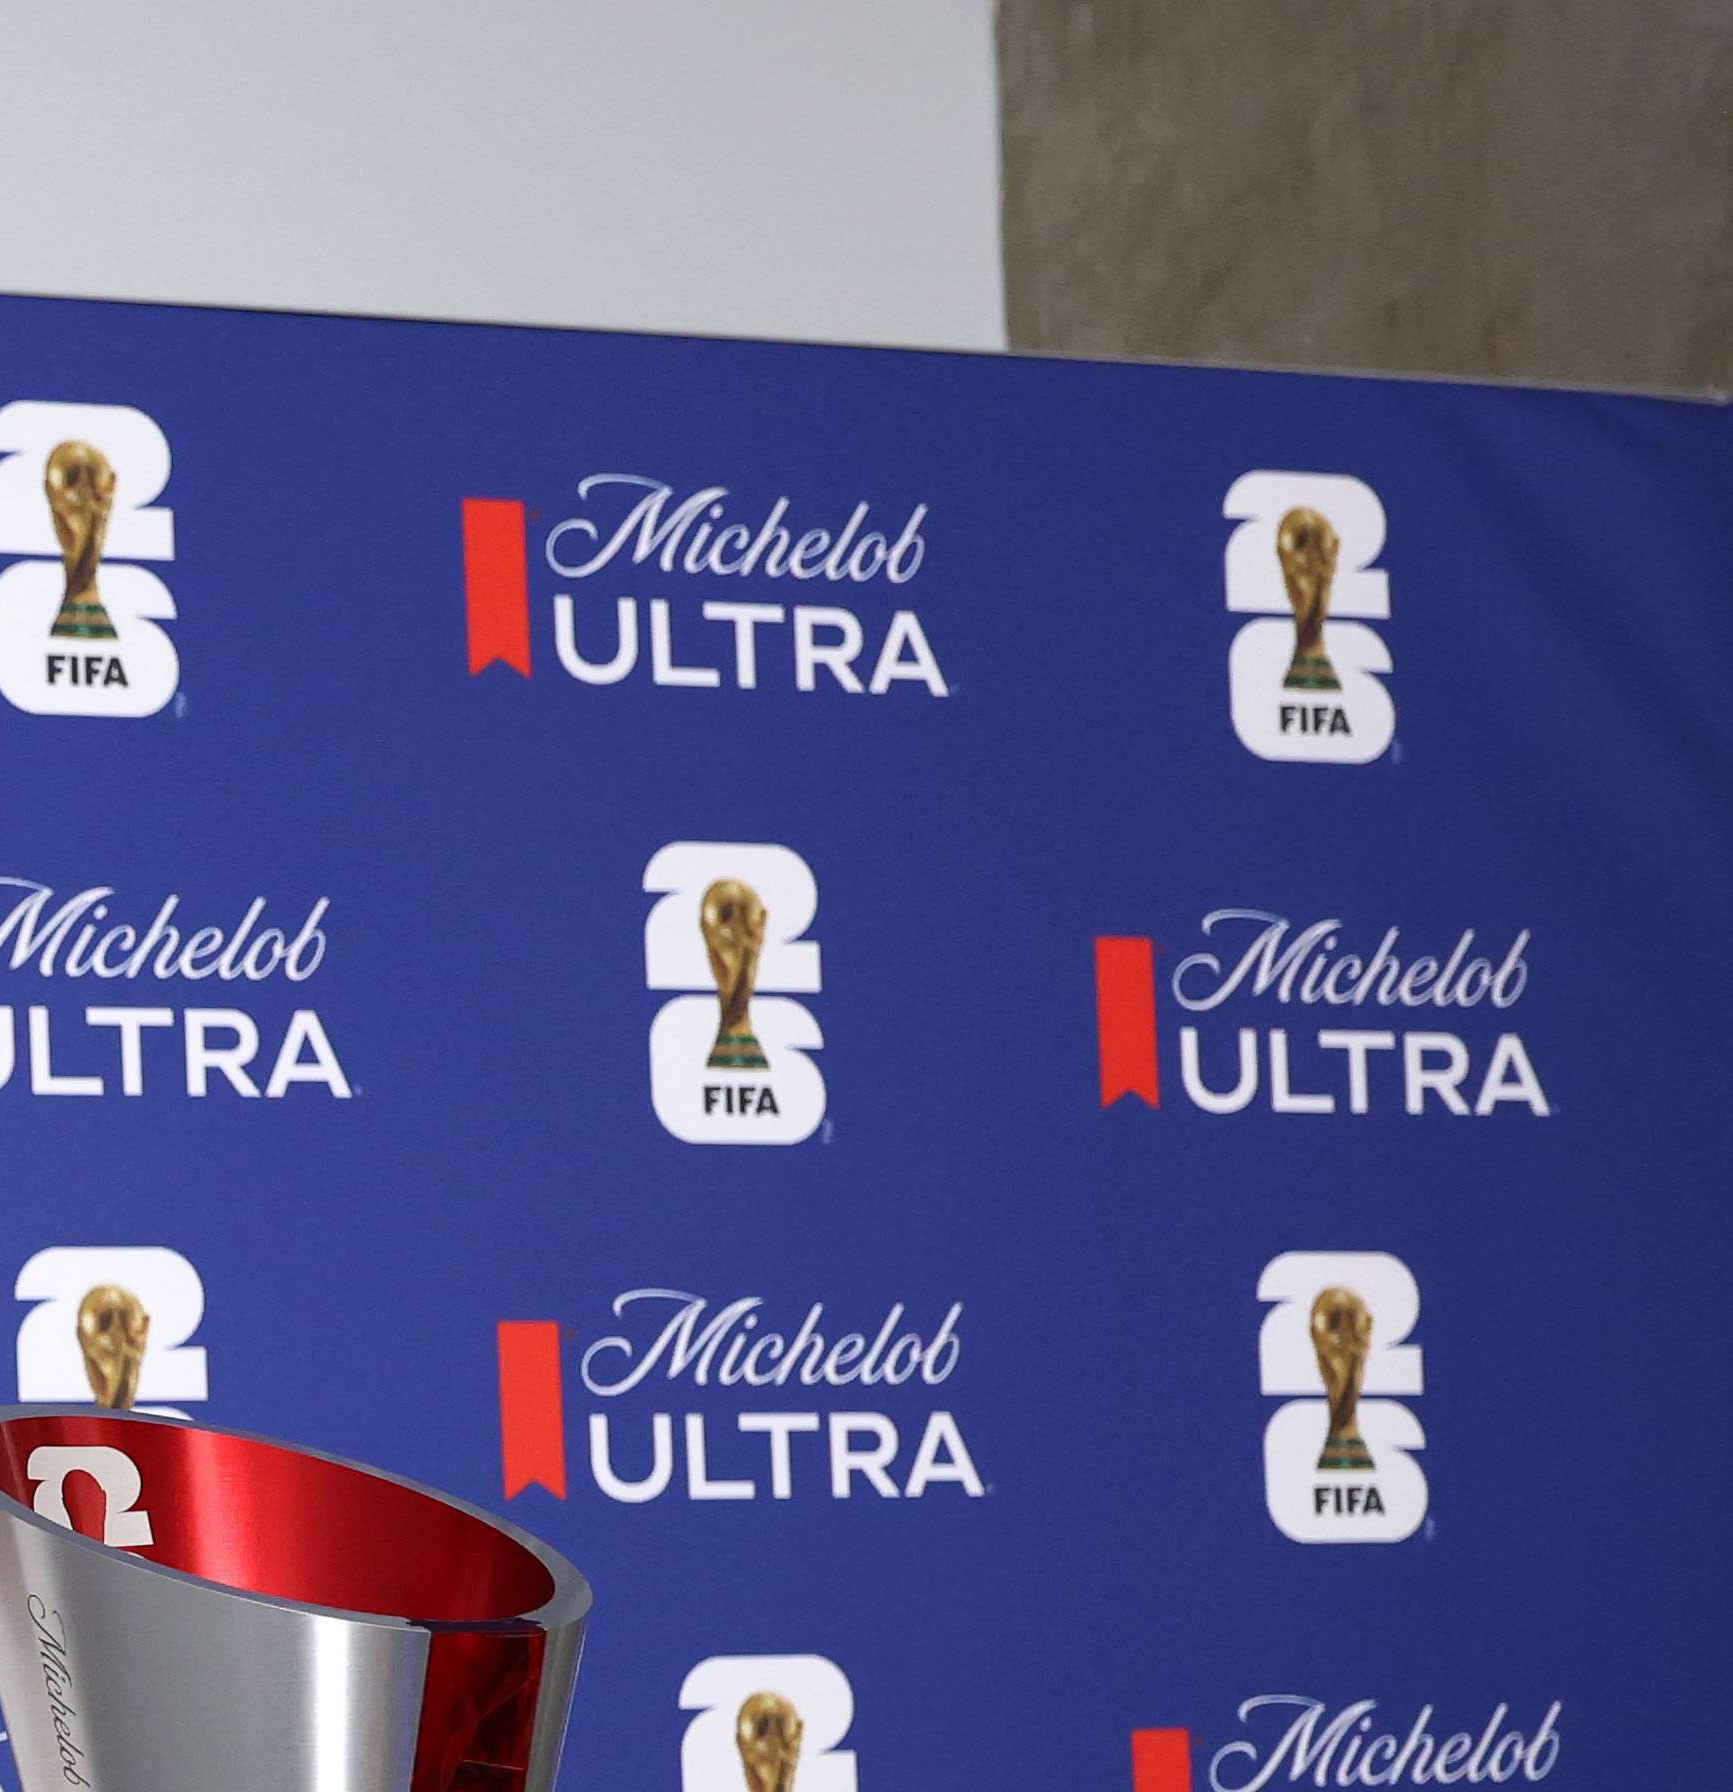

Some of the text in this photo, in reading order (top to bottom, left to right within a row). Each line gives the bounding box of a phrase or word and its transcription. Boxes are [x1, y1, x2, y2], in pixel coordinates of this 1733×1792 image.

[546, 474, 927, 583] Michelob
[48, 656, 127, 686] FIFA
[554, 595, 948, 696] ULTRA
[1281, 706, 1350, 733] FIFA
[1173, 910, 1529, 1010] Michelob
[705, 1087, 778, 1114] FIFA
[1180, 1027, 1549, 1116] ULTRA
[582, 1289, 961, 1395] Michelob
[590, 1412, 984, 1502] ULTRA
[1315, 1487, 1384, 1513] FIFA
[27, 1594, 90, 1788] Michelob
